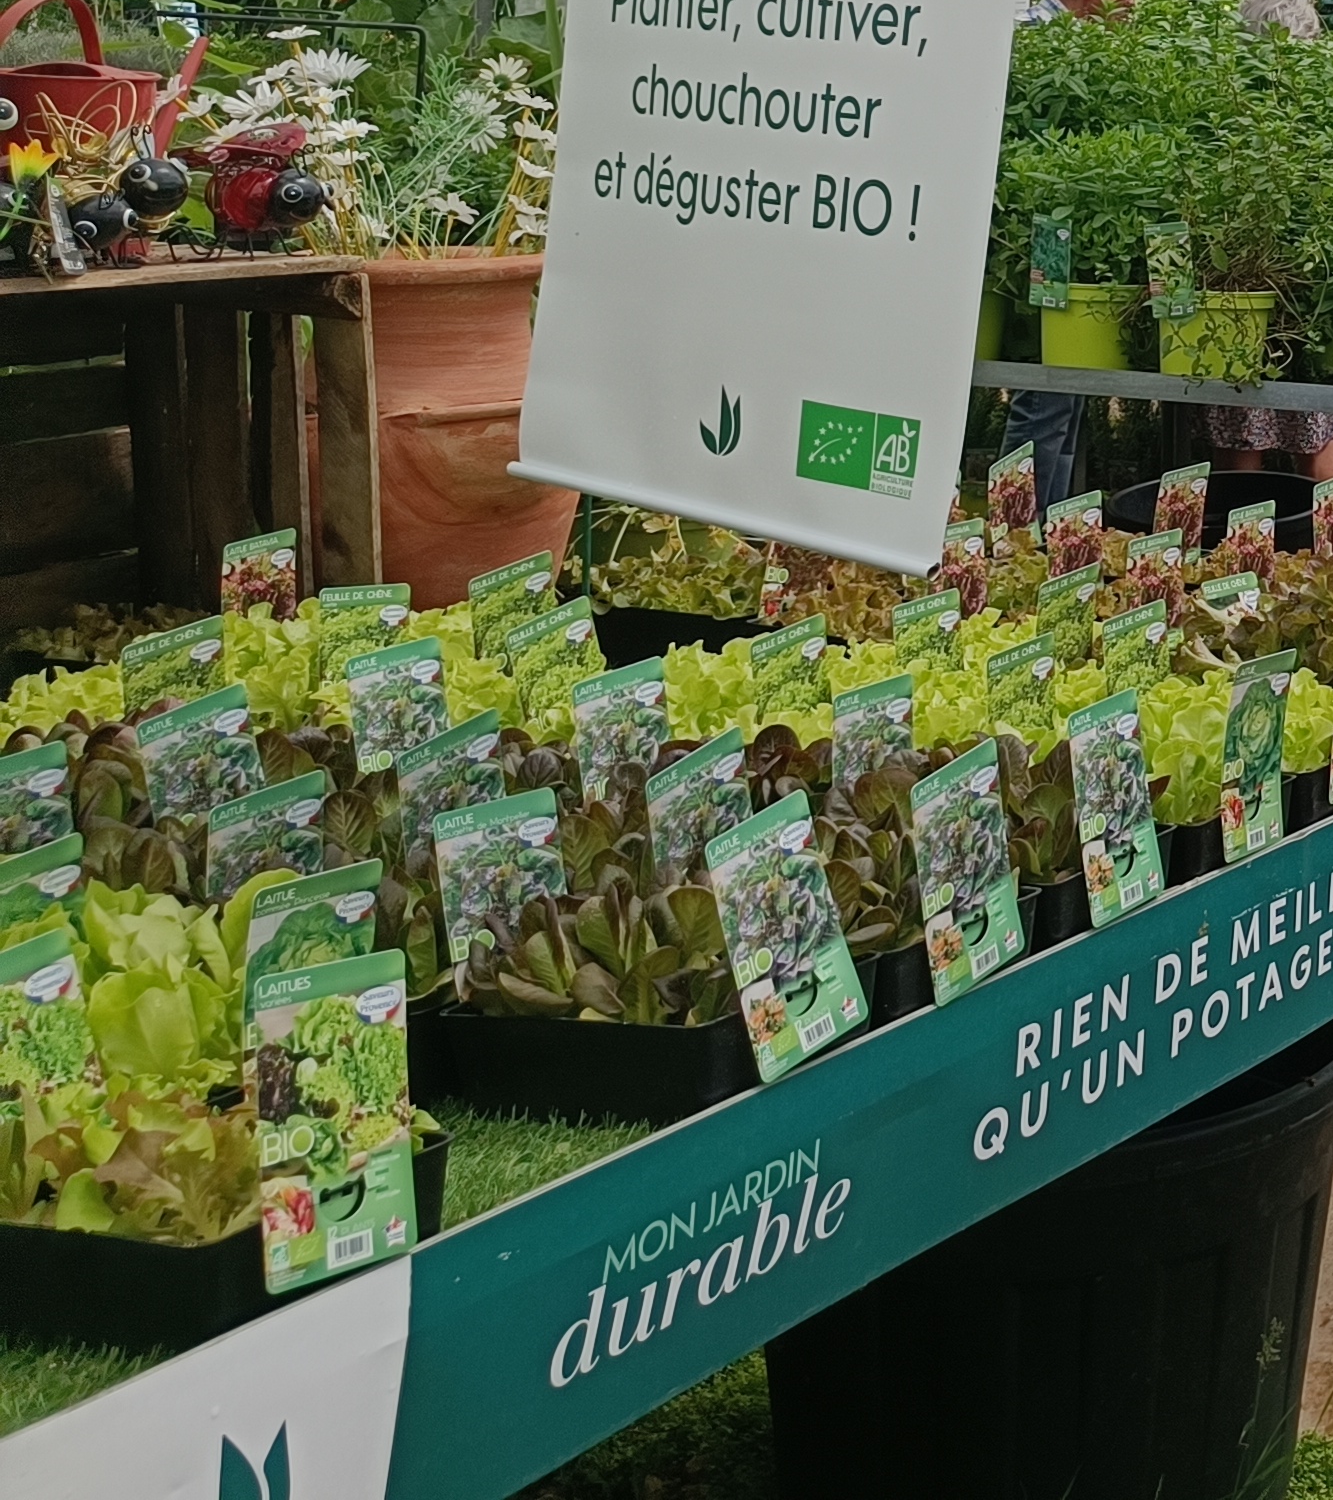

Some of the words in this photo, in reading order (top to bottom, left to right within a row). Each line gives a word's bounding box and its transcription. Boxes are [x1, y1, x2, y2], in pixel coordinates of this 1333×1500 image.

[631, 64, 881, 139] chouchouter
[594, 157, 627, 200] et
[633, 154, 800, 226] déguster
[812, 173, 894, 237] BIO
[907, 184, 922, 242] !
[875, 431, 911, 474] AB
[871, 482, 913, 499] BIOLOGIQUE
[872, 471, 914, 488] AGRICULTURE
[765, 565, 789, 584] BIO
[322, 591, 350, 602] FEUILLE
[353, 591, 365, 600] DE
[124, 643, 156, 661] FEUILLE
[159, 638, 172, 648] DE
[349, 657, 377, 673] LAITUE
[574, 680, 603, 698] LAITUE
[140, 717, 173, 738] LAITUE
[400, 746, 431, 769] LAITUE
[649, 769, 678, 792] LAITUE
[1223, 759, 1245, 783] BIO
[212, 802, 248, 822] LAITUE
[437, 812, 475, 832] LAITUE
[1081, 812, 1107, 844] BIO
[709, 834, 741, 860] LAITUE
[256, 887, 297, 909] LAITUE
[924, 882, 955, 920] BIO
[453, 929, 495, 963] BO
[736, 947, 773, 990] BIO
[259, 975, 312, 999] LAITUES
[1015, 973, 1130, 1079] RIEN
[1154, 934, 1210, 1005] DE
[973, 1029, 1145, 1161] QU'UN
[262, 1125, 315, 1167] BIO
[601, 1208, 698, 1286] MON
[702, 1138, 822, 1236] JARDIN
[548, 1173, 853, 1389] durable
